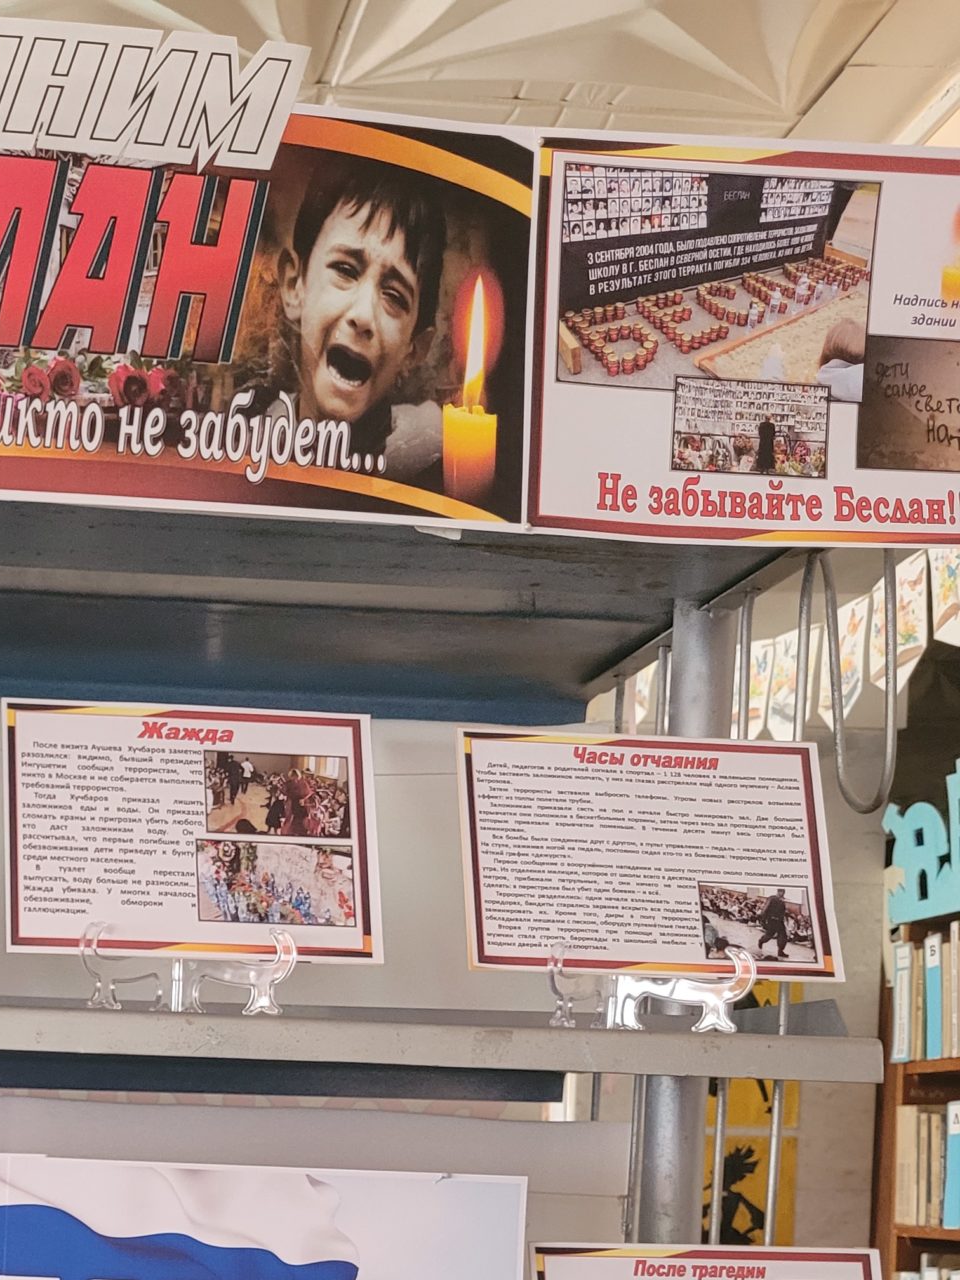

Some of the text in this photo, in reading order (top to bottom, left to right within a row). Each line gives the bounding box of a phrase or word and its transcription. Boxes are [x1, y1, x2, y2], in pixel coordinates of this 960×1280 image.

[587, 253, 594, 265] 3
[595, 249, 634, 263] СЕНТЯБРЯ
[636, 244, 653, 257] 2004
[589, 264, 620, 280] ШКОЛУ
[622, 263, 628, 275] В
[639, 257, 669, 272] БЕСЛАН
[670, 255, 675, 266] В
[676, 249, 708, 265] СЕВЕРНОЙ
[589, 284, 596, 296] В
[598, 273, 652, 293] РЕЗУЛЬТАТЕ
[654, 268, 677, 281] ЭТОГО
[678, 262, 714, 278] ТЕРРАКТА
[893, 294, 948, 308] Надпись
[911, 314, 957, 328] здании
[118, 405, 166, 456] не
[177, 391, 387, 485] забудет...
[596, 472, 638, 513] Не
[648, 474, 822, 521] забывайте
[138, 721, 234, 744] Жажда
[573, 746, 719, 769] Часы отчаяния
[147, 806, 160, 814] Он
[182, 828, 194, 836] Он
[633, 1259, 768, 1280] После трагедии
